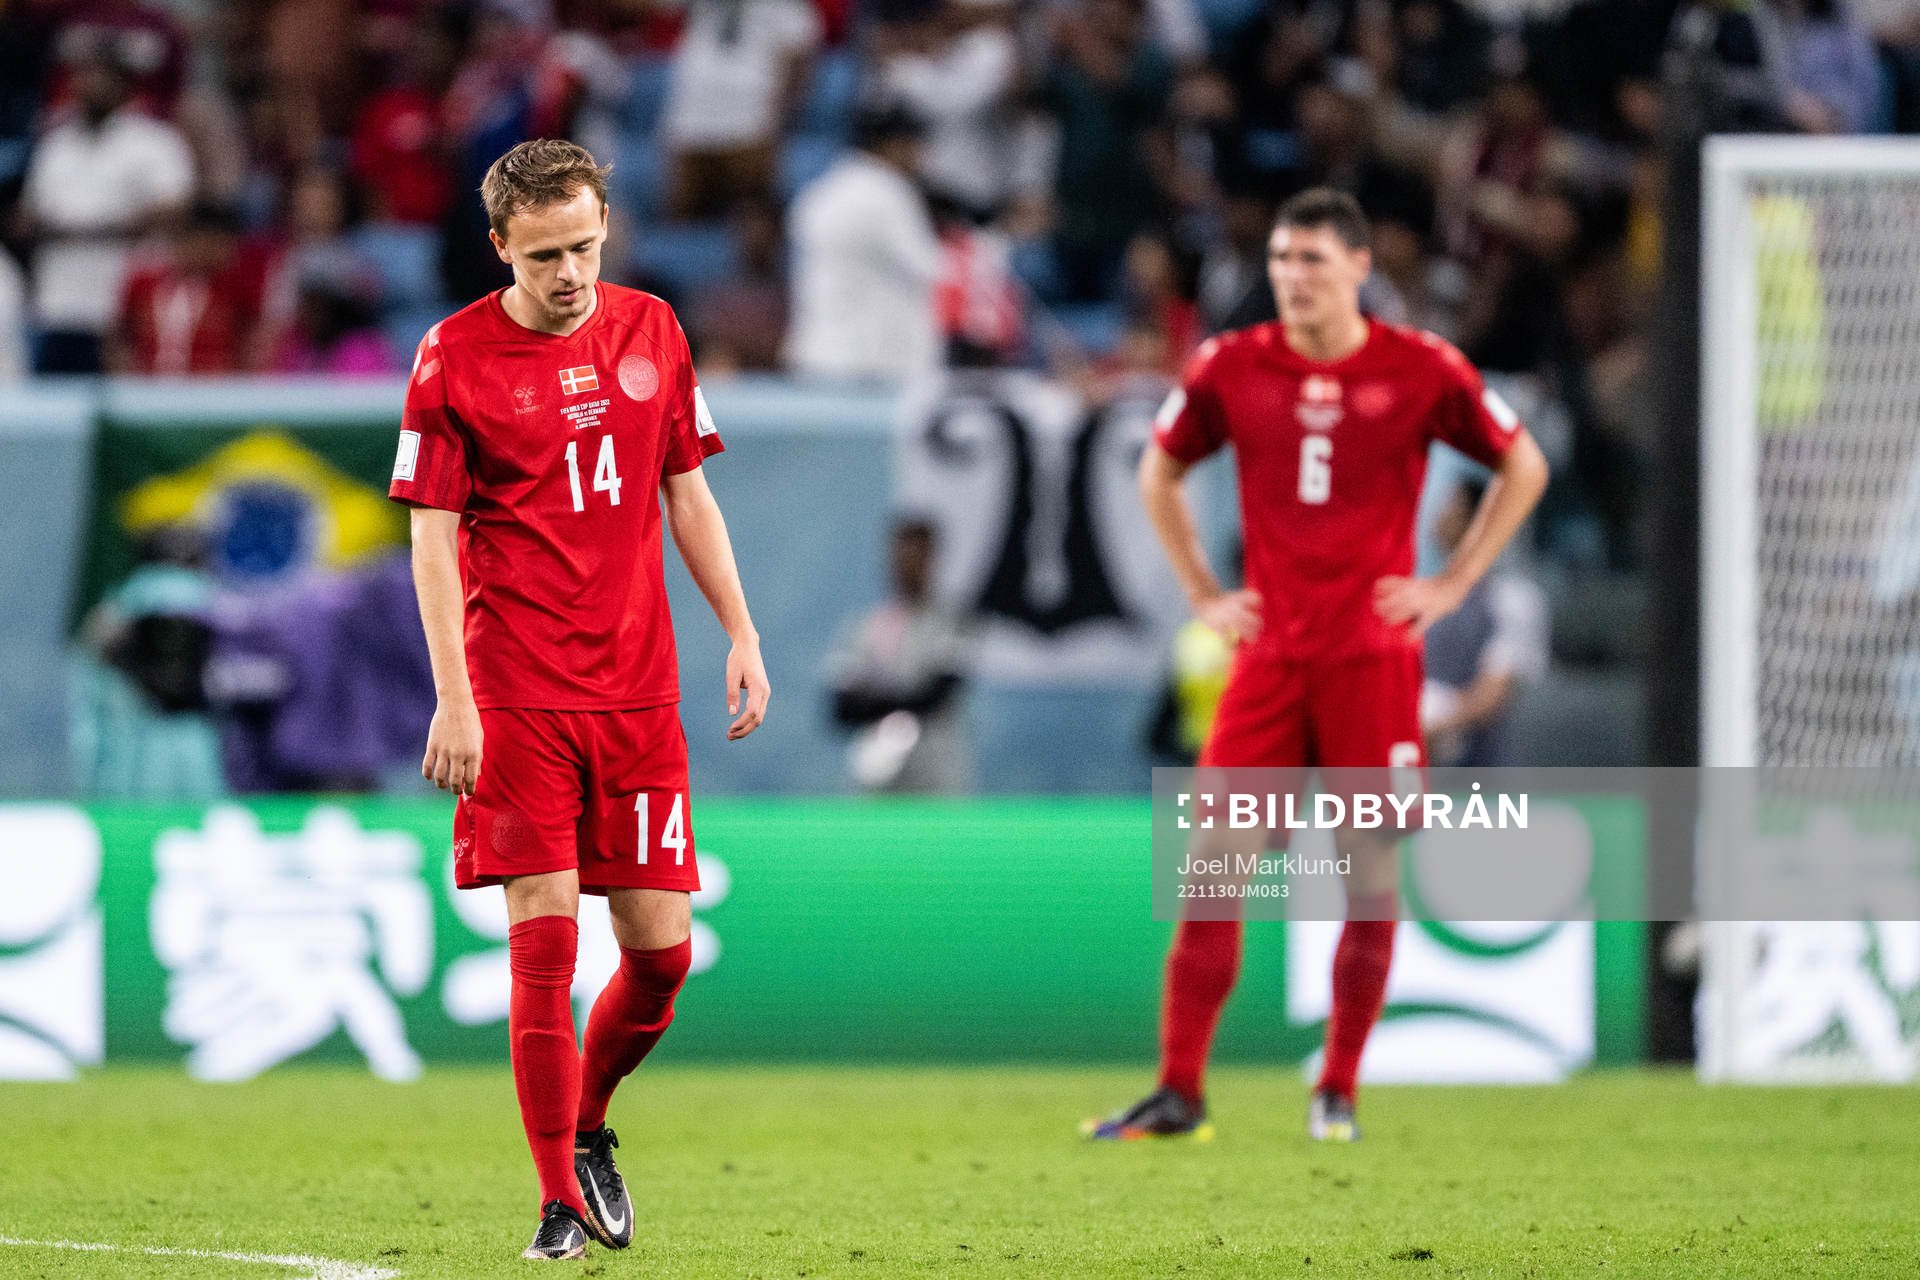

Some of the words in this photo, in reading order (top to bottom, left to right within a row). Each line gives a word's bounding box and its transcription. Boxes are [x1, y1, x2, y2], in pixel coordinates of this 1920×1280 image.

[565, 435, 622, 512] 14
[1298, 433, 1333, 504] 6
[634, 792, 687, 866] 14
